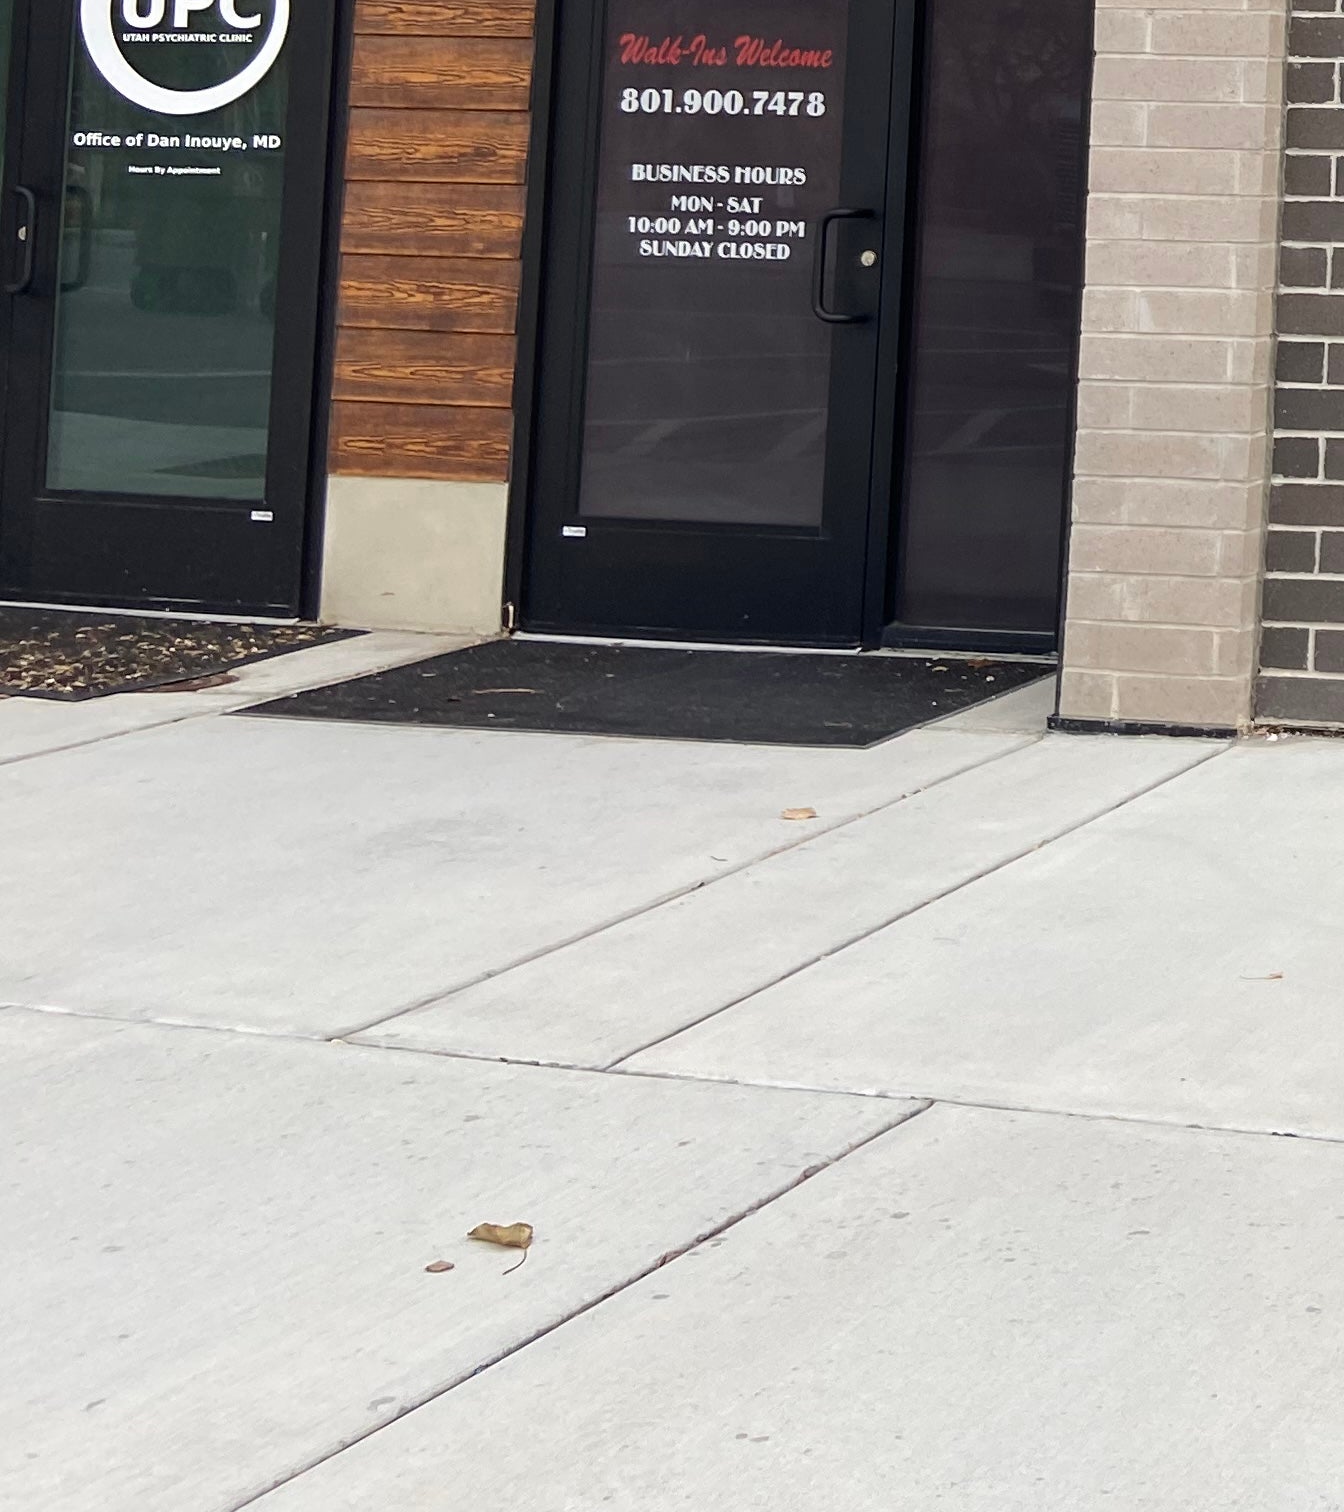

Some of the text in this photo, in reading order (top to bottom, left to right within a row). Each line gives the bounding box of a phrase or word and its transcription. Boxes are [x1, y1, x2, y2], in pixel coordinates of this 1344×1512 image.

[122, 33, 253, 43] UTAH PSYCHIATRIC CLINIC
[619, 33, 834, 69] Walk-Ins Welcome
[620, 87, 827, 118] 801.900.7478
[73, 132, 282, 151] Office of Dan Inouye, MD
[128, 165, 222, 176] Hours By Appointment
[631, 163, 807, 186] BUSINESS HOURS
[671, 194, 715, 213] MON
[727, 196, 764, 214] SAT
[628, 216, 682, 235] 10:00
[684, 218, 714, 236] AM
[728, 219, 773, 237] 9:00
[775, 220, 807, 238] PM
[639, 240, 791, 260] SUNDAY CLOSED
